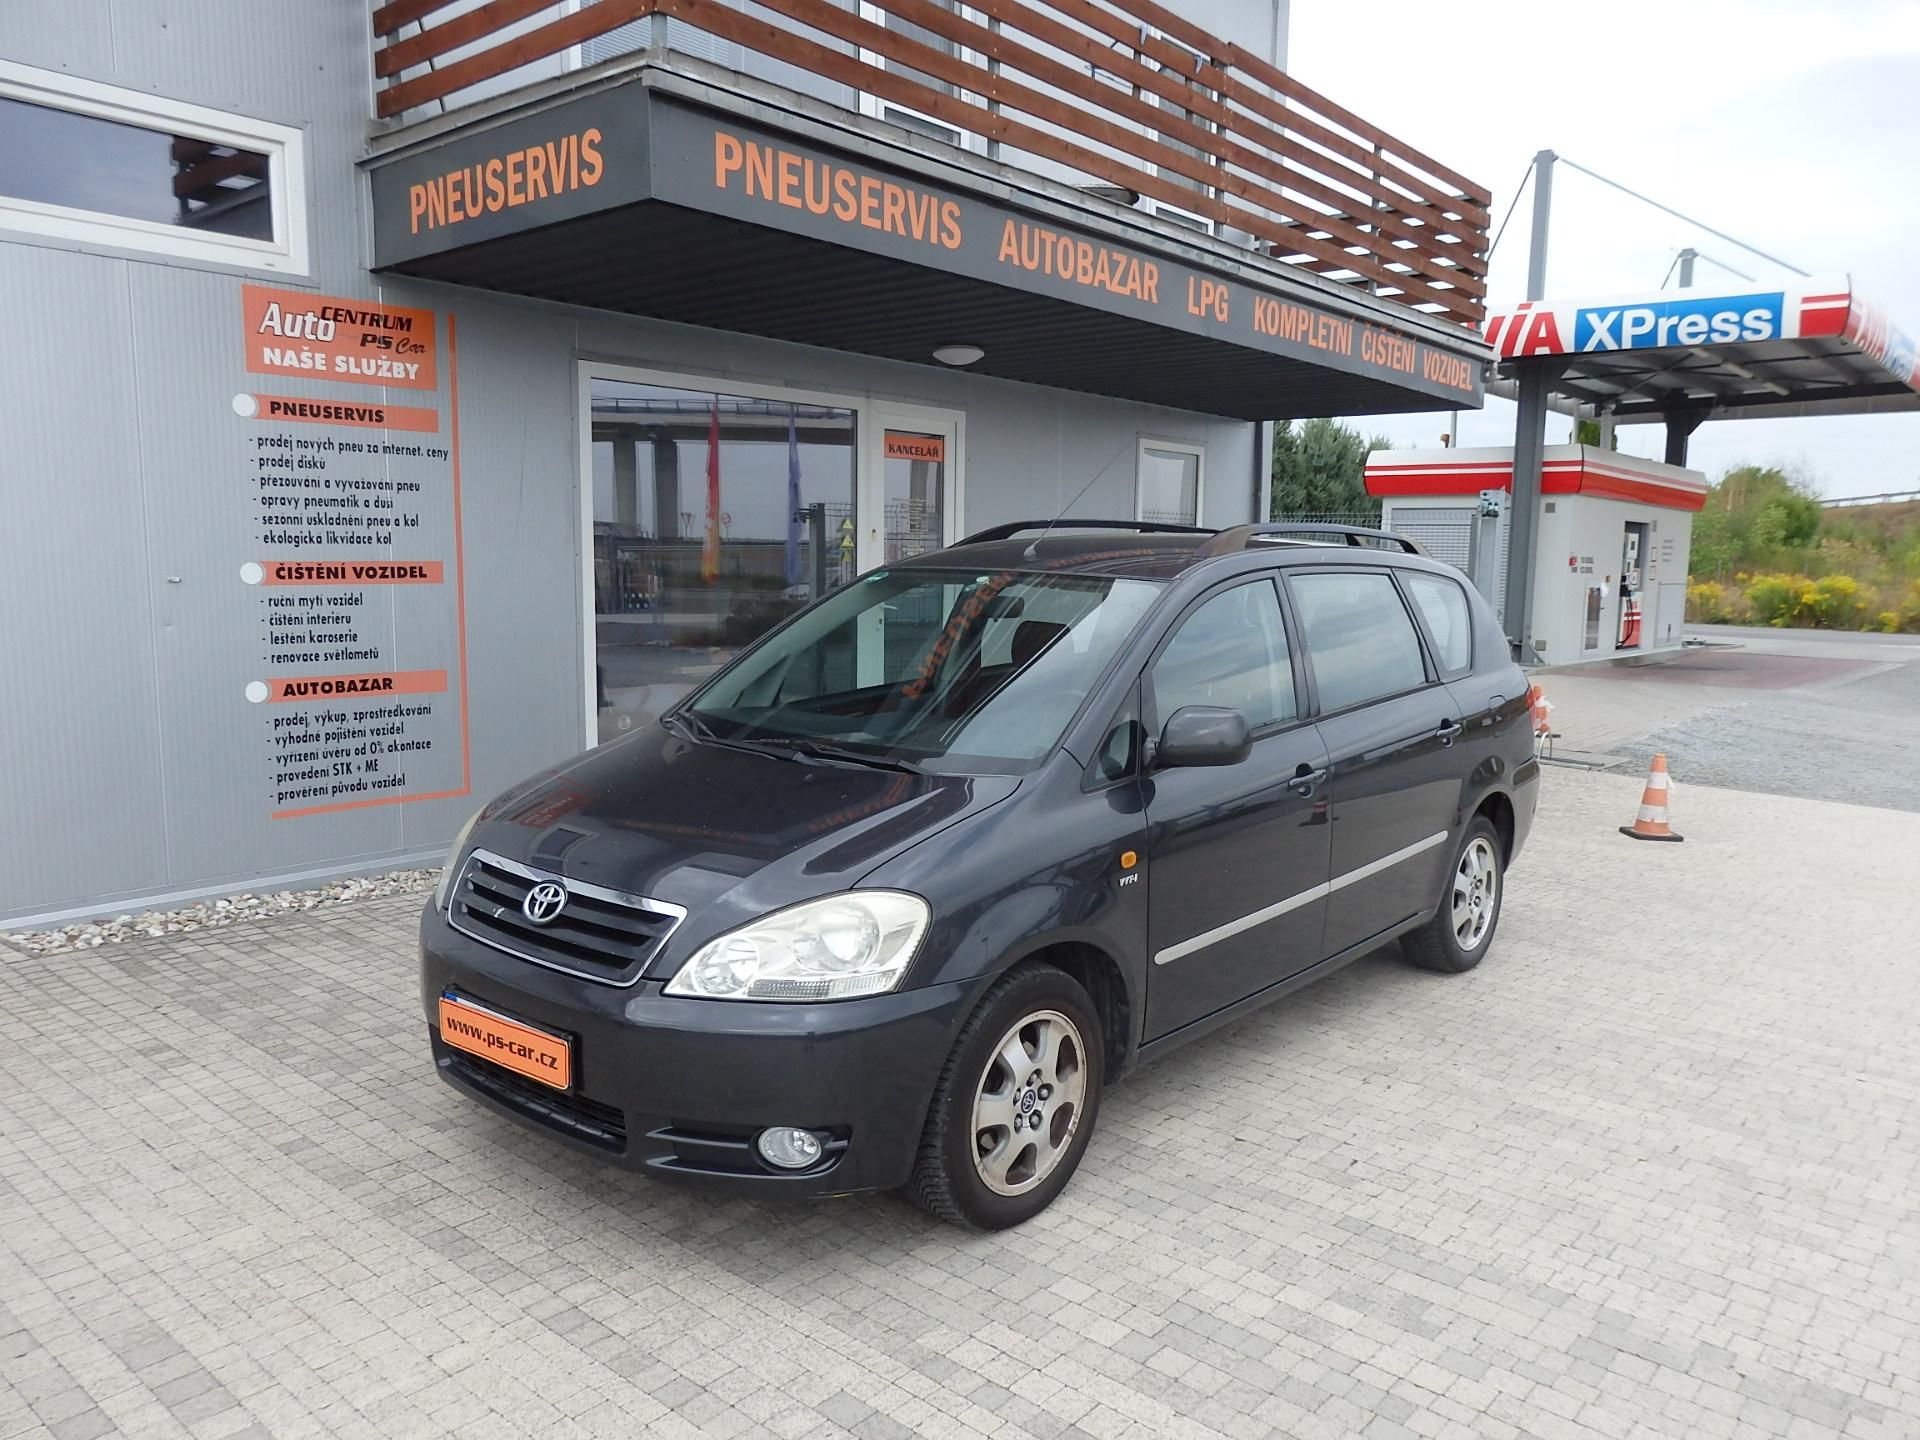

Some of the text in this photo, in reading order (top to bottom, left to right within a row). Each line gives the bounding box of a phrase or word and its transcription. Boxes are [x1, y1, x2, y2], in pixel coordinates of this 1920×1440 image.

[410, 127, 604, 235] PNEUSERVIS
[714, 131, 1473, 392] PNEUSERVIS AUTOBAZAR LPG KOMPLETNÍ ČIŠTĚNÍ VOZIDEL
[257, 301, 412, 342] Auto CENTRUM
[1584, 308, 1774, 352] XPress
[360, 333, 426, 355] PS Car
[263, 345, 419, 380] NAŠE SLUŽBY
[270, 401, 385, 423] PNEUSERVIS
[257, 434, 449, 461] prodej nových pneu za internet. ceny
[888, 443, 940, 458] KANCELÁŘ
[259, 453, 294, 472] prodej
[260, 474, 421, 495] přezouvání a vyvažování pneu
[261, 496, 300, 510] opravy
[304, 494, 360, 510] pneumatik
[364, 499, 370, 508] a
[262, 511, 419, 530] sezónní uskladnění pneu a kol
[263, 529, 392, 548] ekologická likvidace kol
[275, 562, 428, 580] ČIŠTĚNÍ VOZIDEL
[268, 594, 295, 608] ruční
[327, 592, 363, 607] vozidel
[269, 611, 352, 626] čištění interiéru
[270, 628, 358, 645] leštění karoserie
[271, 646, 379, 664] renovace světlometů
[283, 677, 394, 697] AUTOBAZAR
[353, 703, 432, 723] zprostředkování
[275, 721, 404, 749] výhodné pojištění vozidel
[322, 747, 351, 760] úvěru
[354, 742, 367, 756] od
[370, 740, 385, 755] 0%
[387, 738, 432, 753] akontace
[277, 765, 329, 786] provedení
[332, 761, 353, 776] STK
[365, 758, 379, 773] ME
[278, 772, 406, 805] prověření původu vozidel
[447, 1016, 559, 1070] www.ps-car.cz
